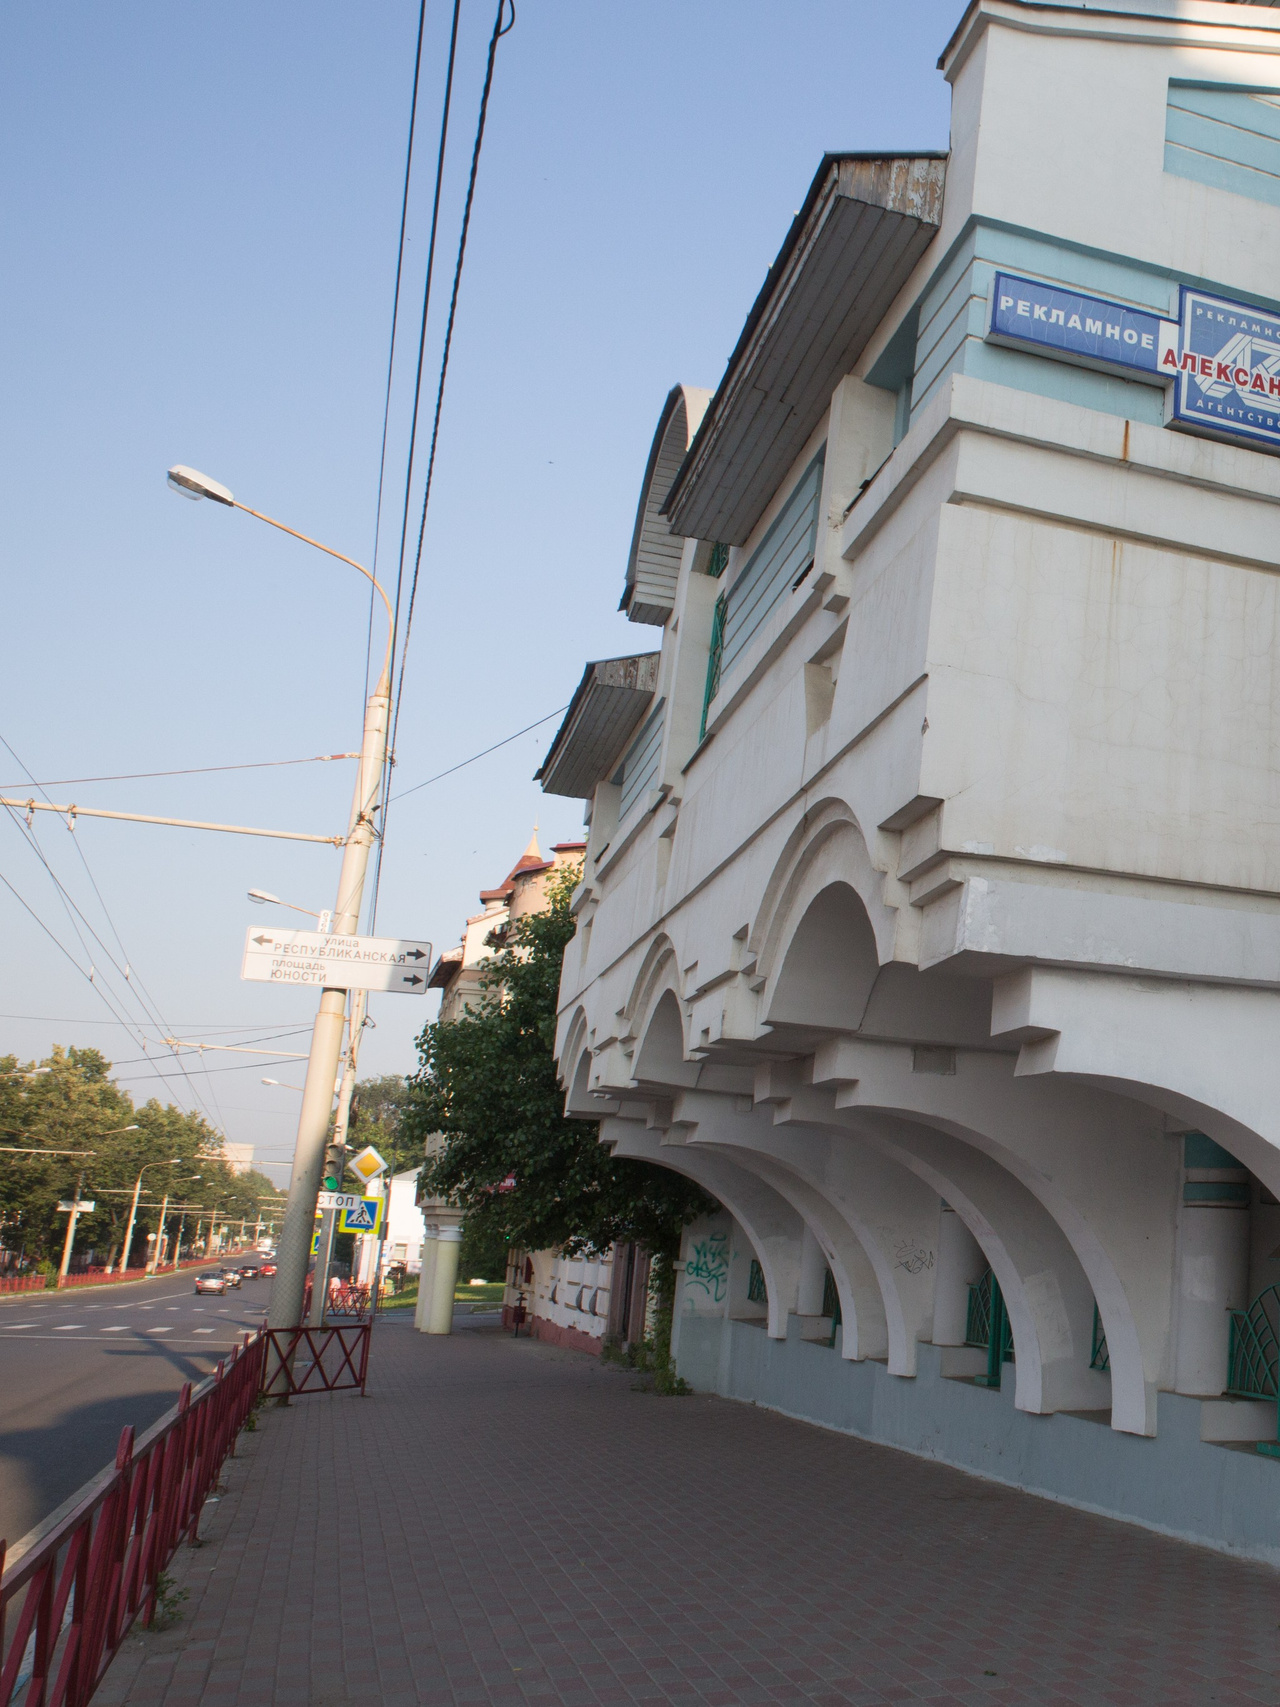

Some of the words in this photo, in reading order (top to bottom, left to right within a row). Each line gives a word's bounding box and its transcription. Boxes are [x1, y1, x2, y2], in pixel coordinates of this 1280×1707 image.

[1000, 295, 1154, 350] РЕКЛАМНОЕ
[324, 937, 359, 948] улица
[274, 943, 406, 963] РЕСПУБЛИКАНСКАЯ
[272, 958, 326, 971] площадь
[270, 969, 327, 983] ЮНОСТИ
[318, 1195, 354, 1207] СТОП
